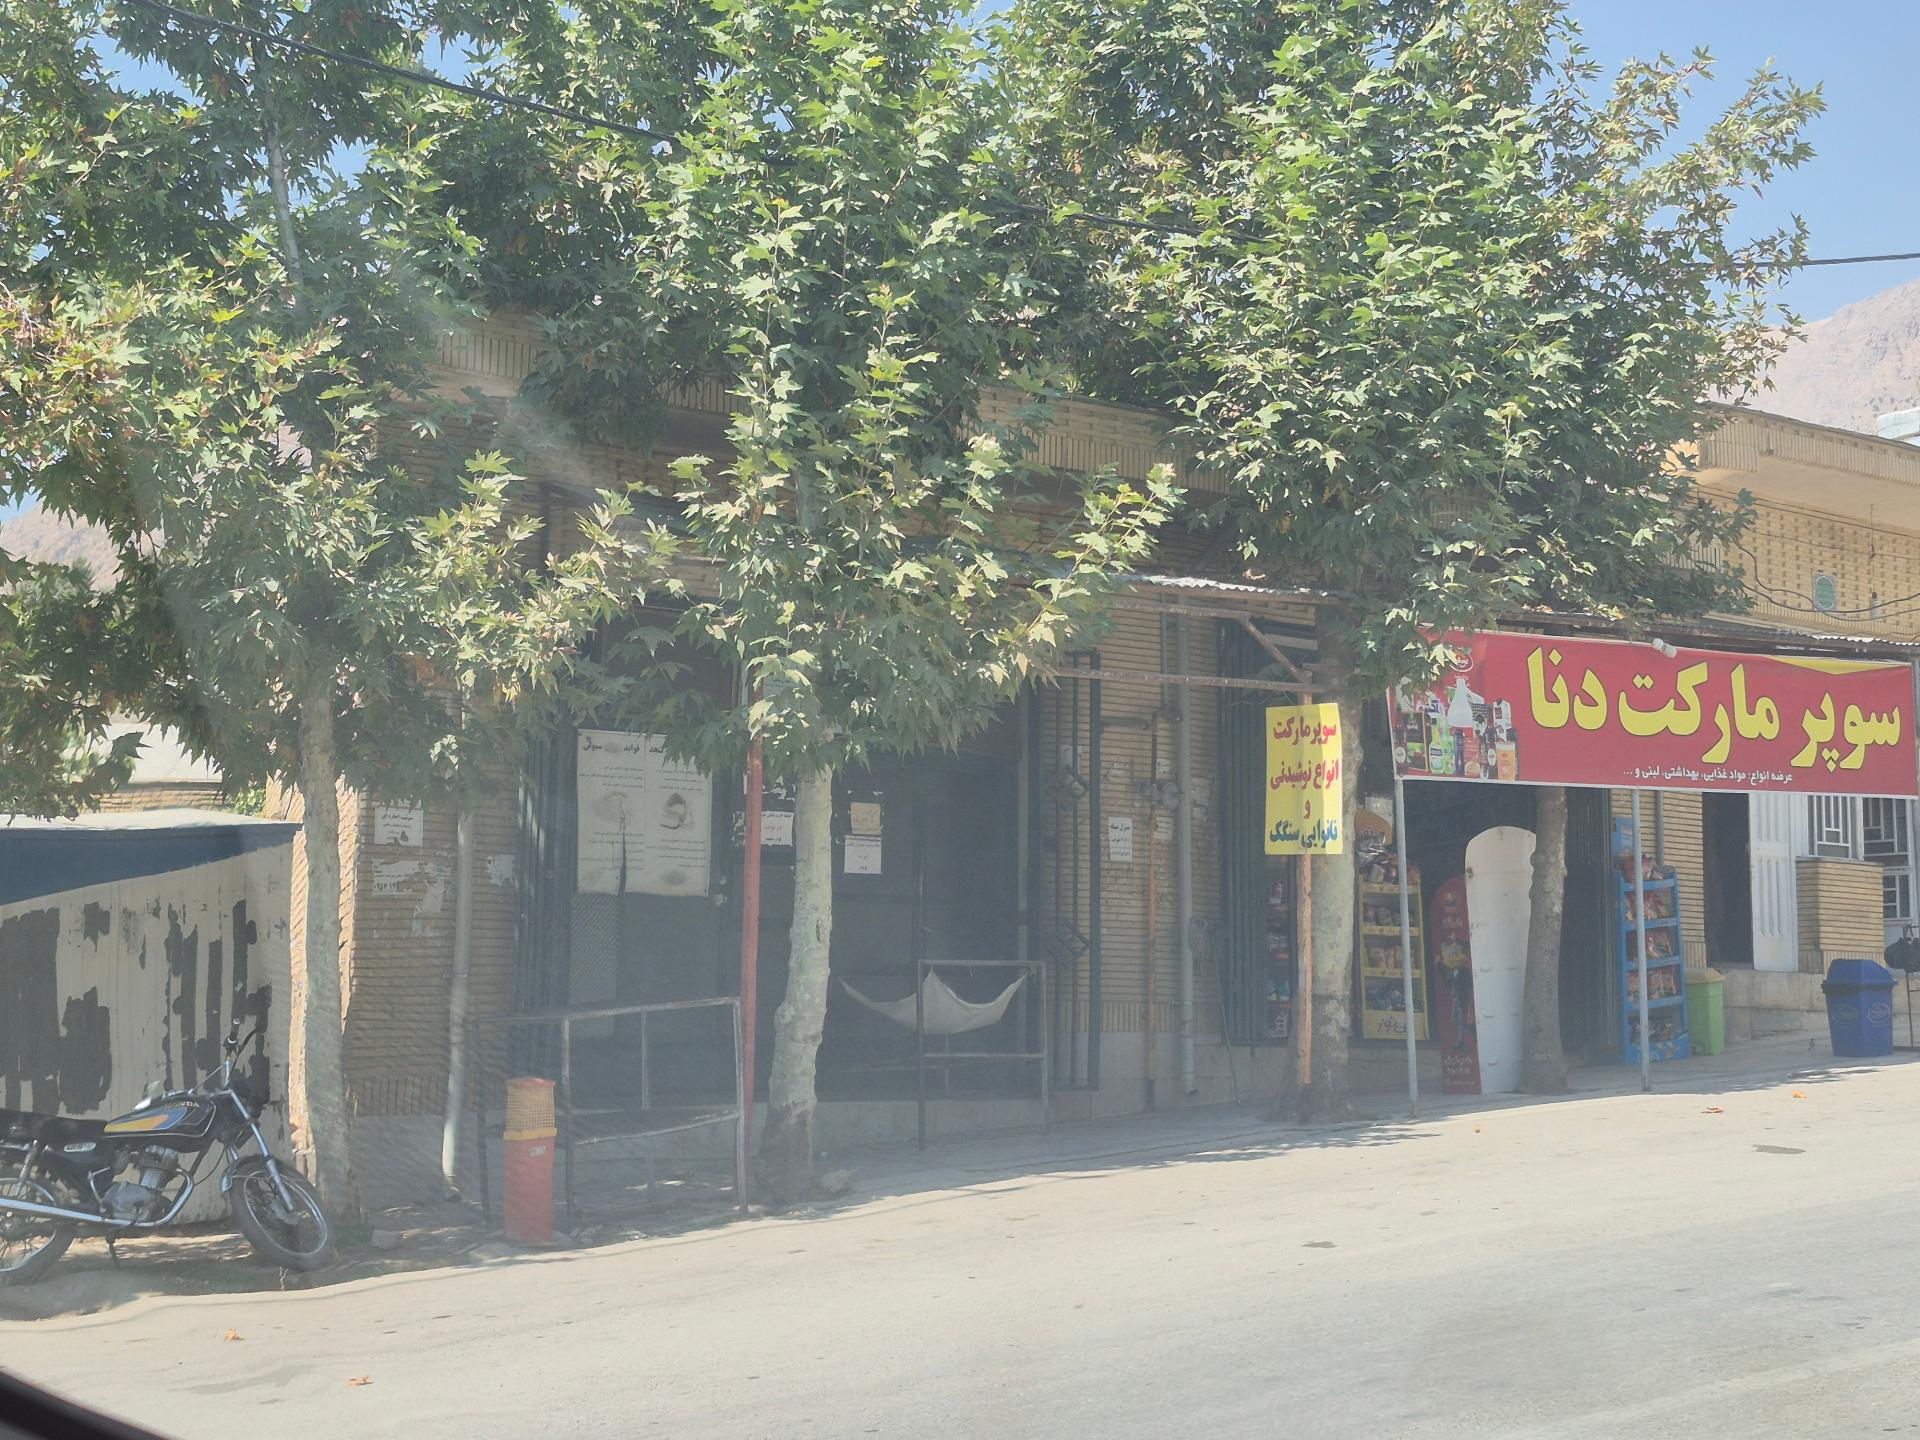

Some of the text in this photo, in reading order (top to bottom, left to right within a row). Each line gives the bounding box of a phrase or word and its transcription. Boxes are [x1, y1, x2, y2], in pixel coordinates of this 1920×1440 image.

[1527, 648, 1901, 773] سوپر مارکت دنا
[1270, 758, 1339, 790] انواع نوشیدنی
[1634, 767, 1640, 779] و
[1641, 765, 1660, 780] لبنی
[1729, 769, 1746, 783] مواد
[1770, 770, 1793, 785] عرضه
[1303, 799, 1311, 819] و
[1269, 819, 1300, 843] سنگک
[1301, 819, 1338, 849] نانوایی
